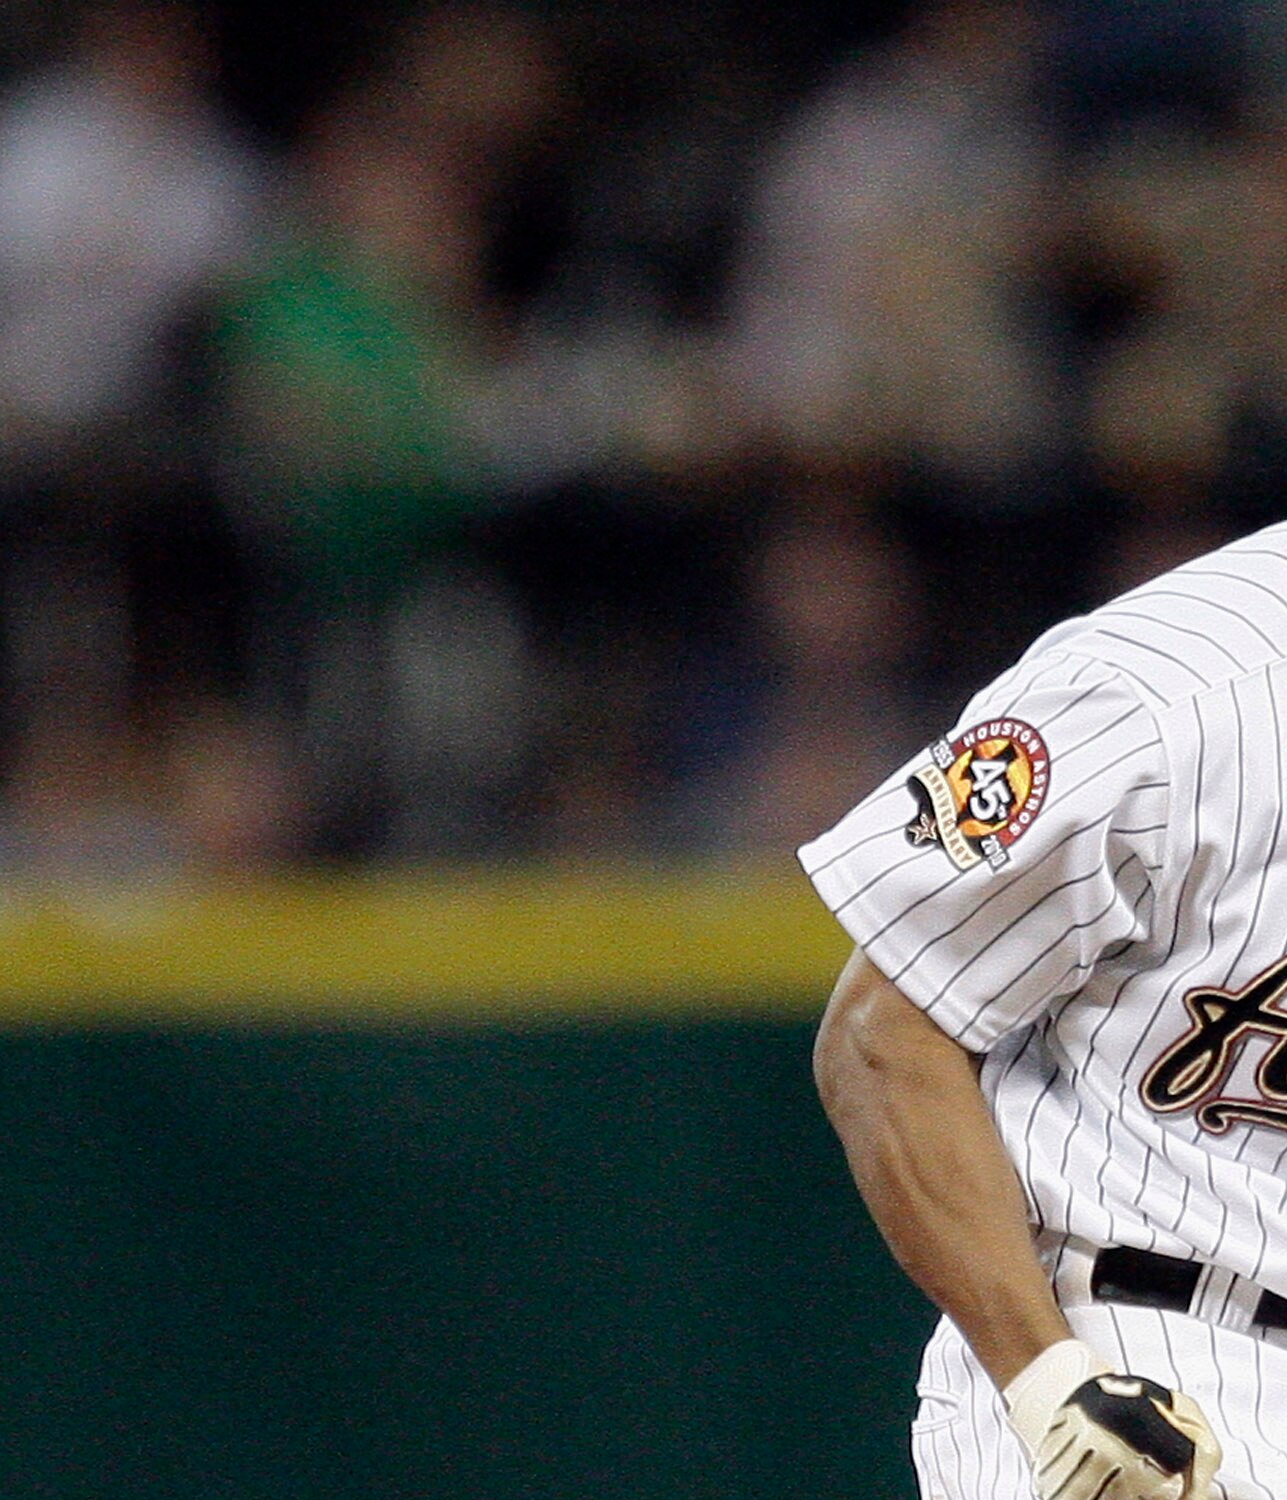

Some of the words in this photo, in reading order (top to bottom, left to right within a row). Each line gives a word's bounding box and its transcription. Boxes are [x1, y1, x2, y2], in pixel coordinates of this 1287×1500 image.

[924, 768, 972, 863] ANNIVERSARY
[963, 722, 1040, 754] HOUSTON
[1009, 760, 1046, 835] ASTROS
